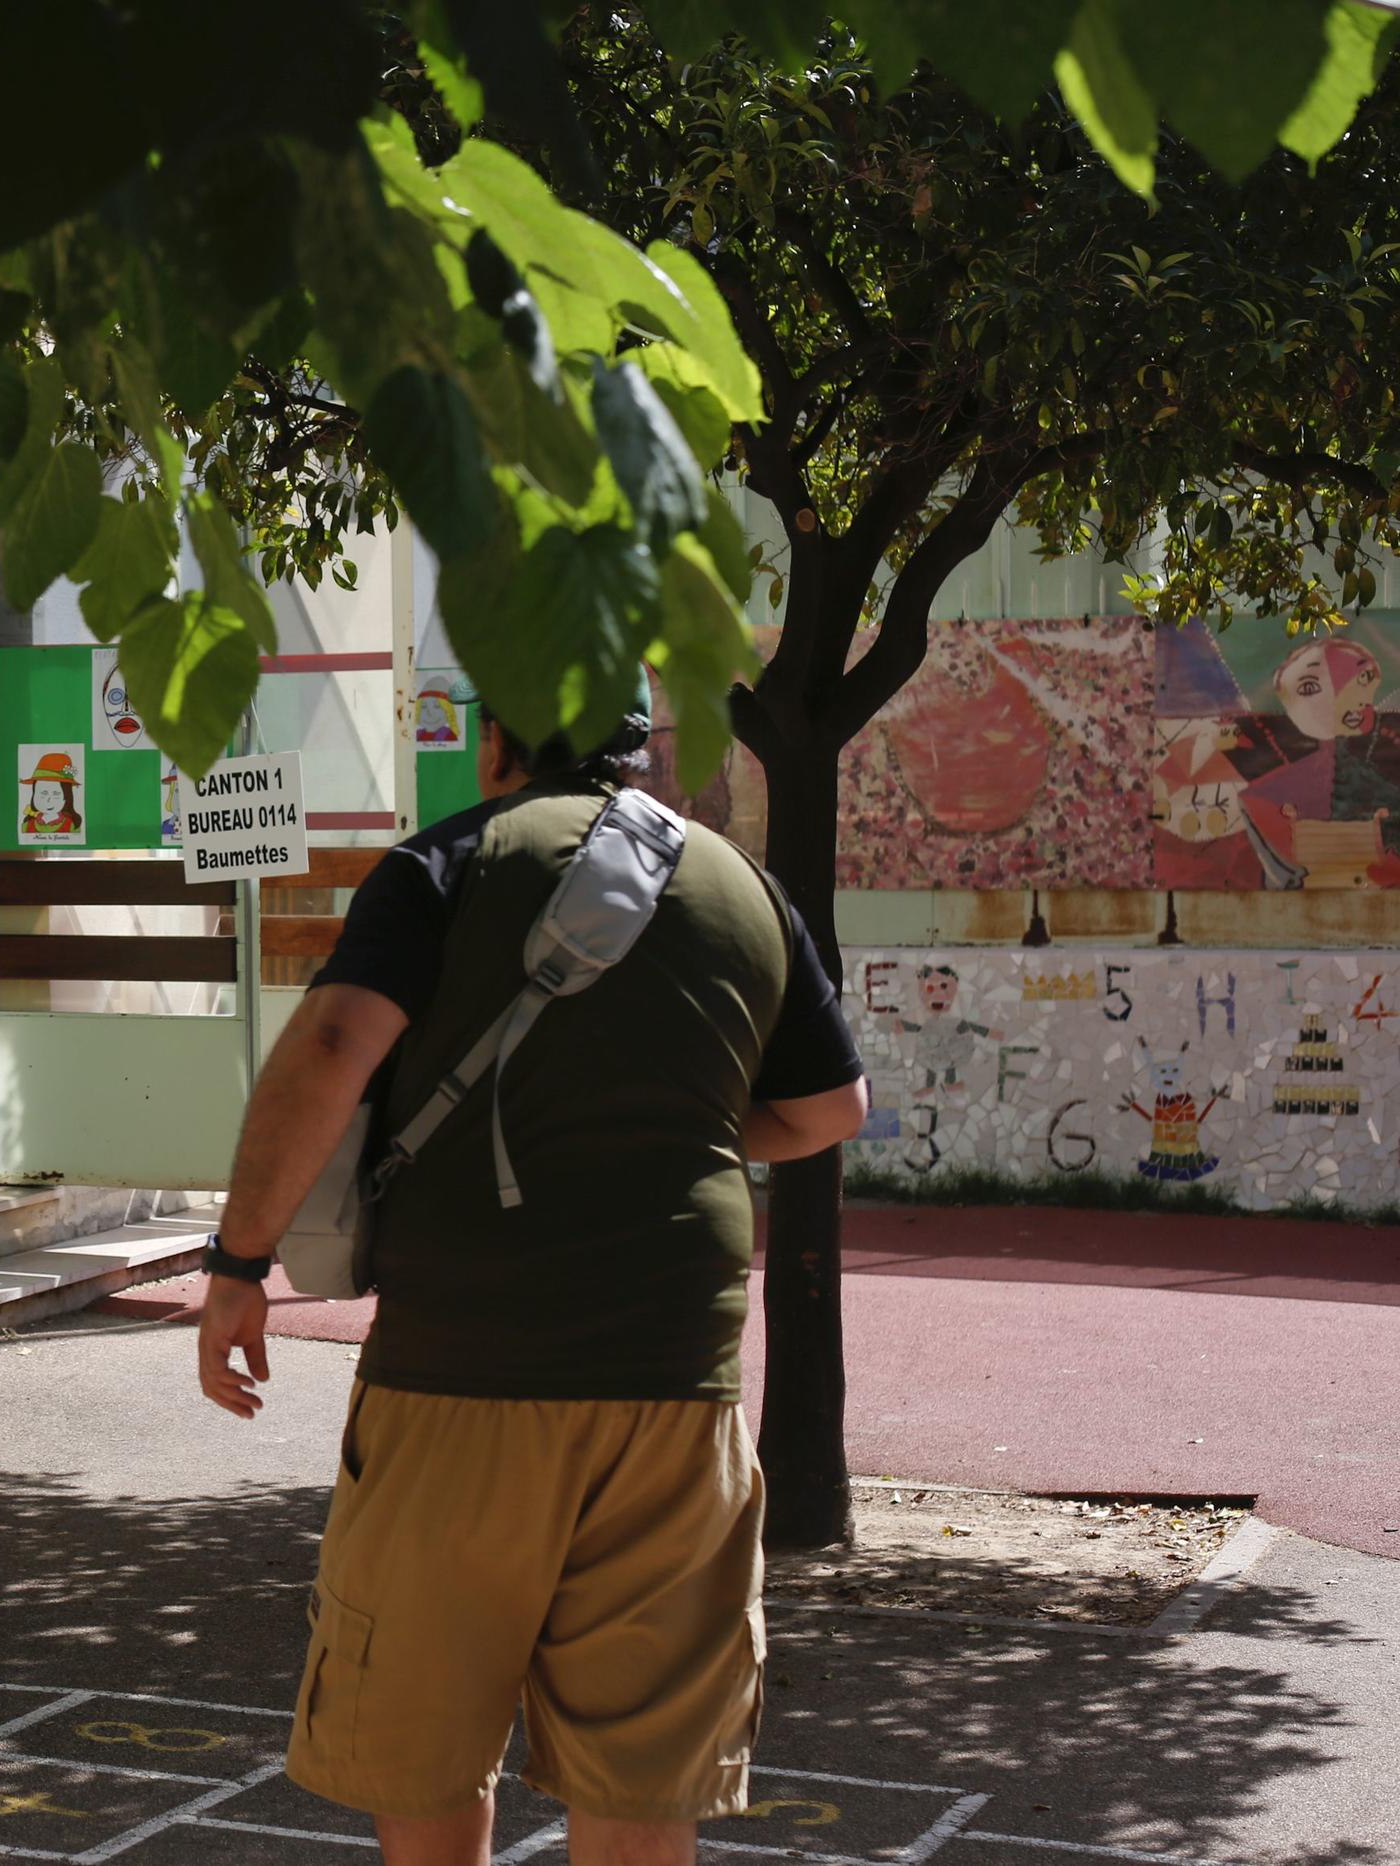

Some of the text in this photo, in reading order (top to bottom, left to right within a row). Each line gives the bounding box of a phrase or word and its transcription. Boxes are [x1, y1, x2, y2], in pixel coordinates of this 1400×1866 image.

[195, 768, 282, 797] CANTON 1
[188, 804, 297, 834] BUREAU 0114
[197, 844, 288, 869] Baumettes
[866, 962, 899, 1013] E
[1103, 965, 1133, 1021] 5
[1196, 972, 1237, 1037] H
[1353, 973, 1400, 1031] 4
[997, 1047, 1039, 1101] F
